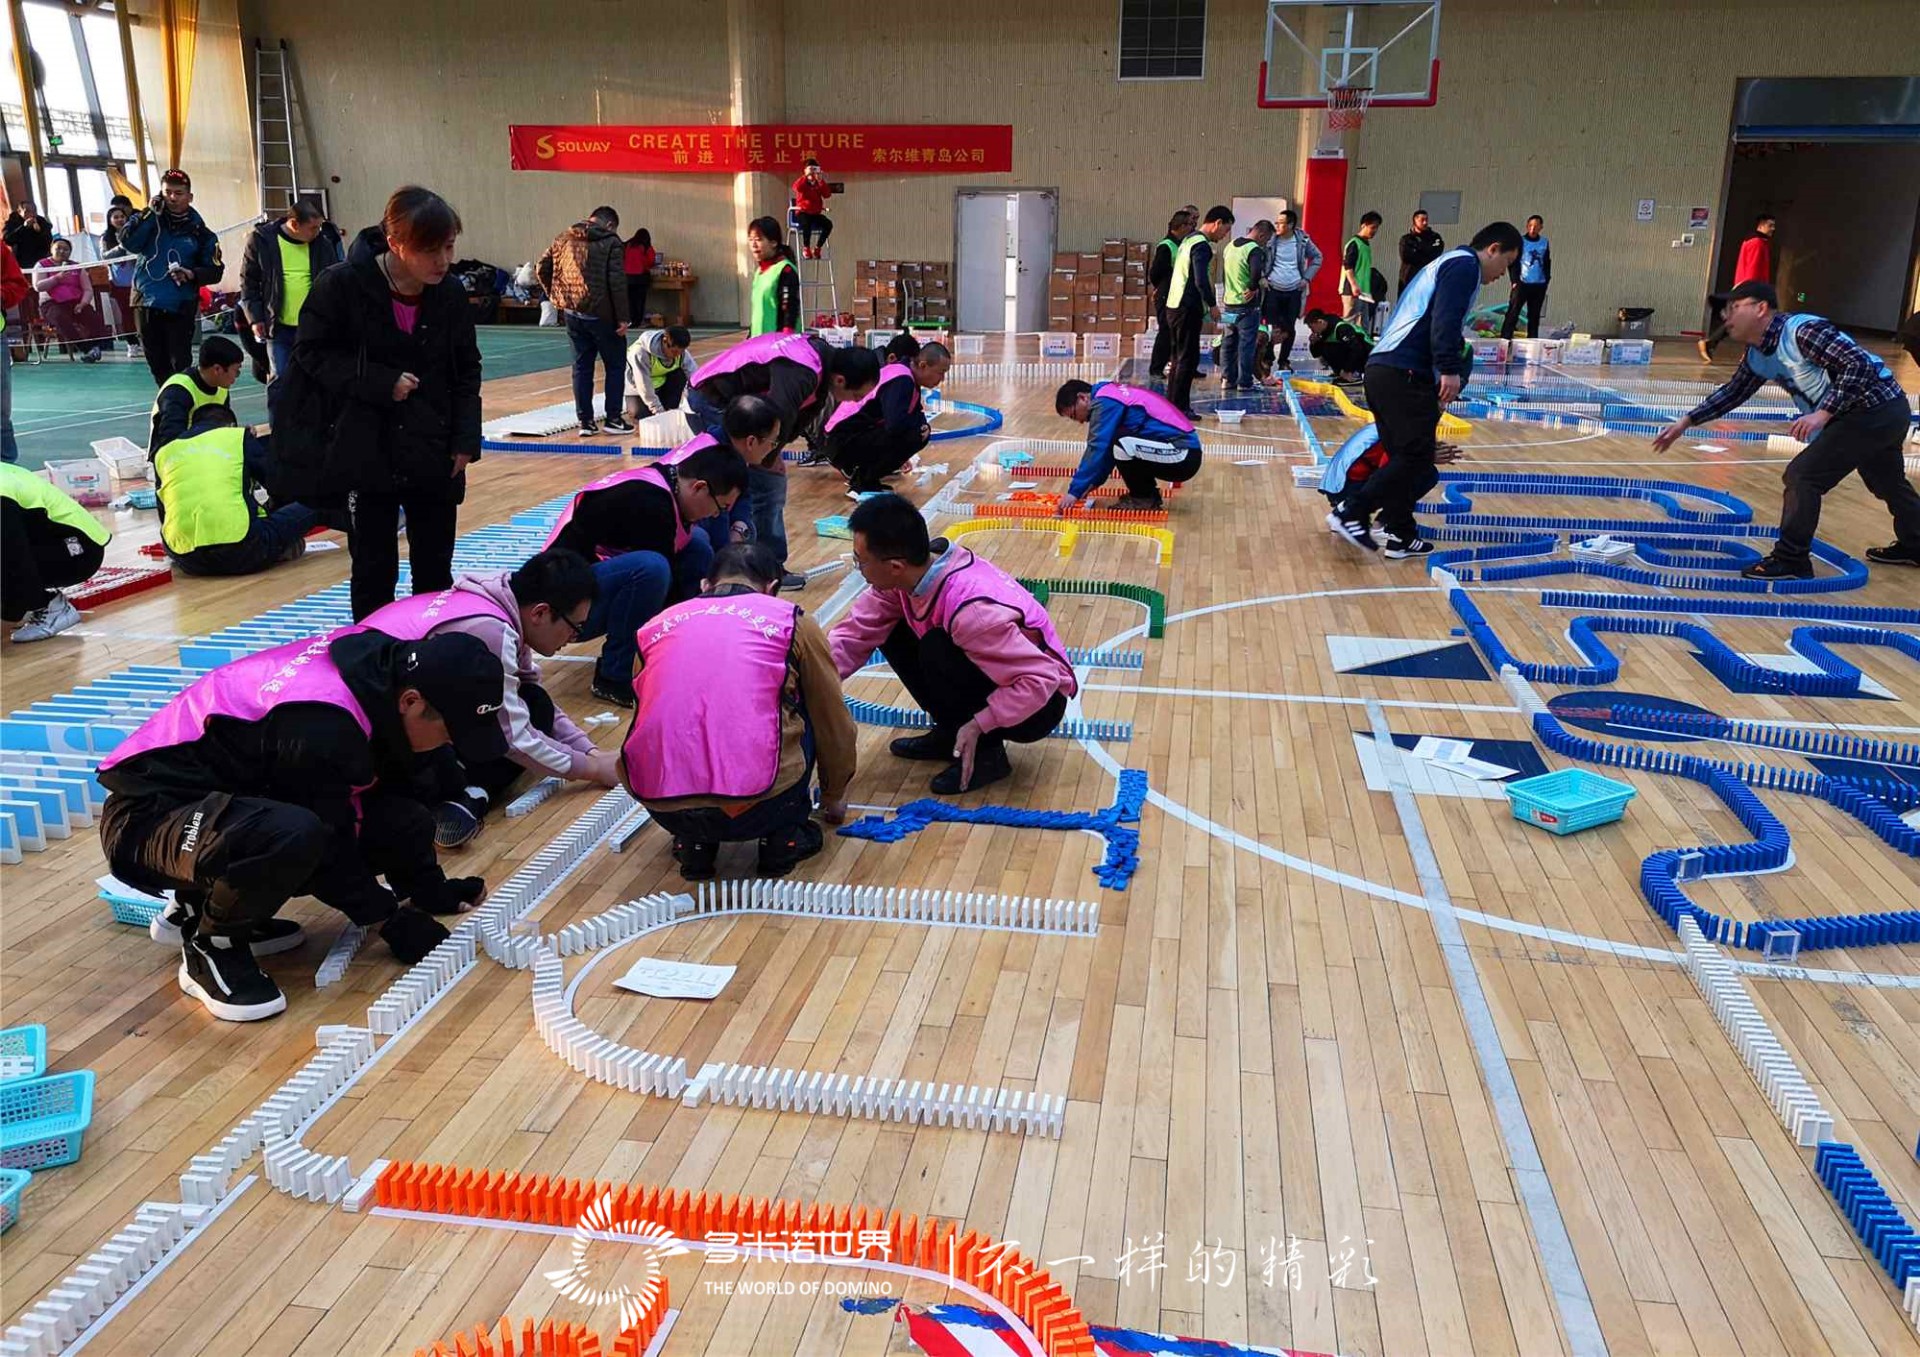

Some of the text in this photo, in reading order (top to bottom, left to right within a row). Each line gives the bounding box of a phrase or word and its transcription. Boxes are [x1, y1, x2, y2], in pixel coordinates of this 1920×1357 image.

[556, 140, 612, 153] SOLVAY
[628, 133, 865, 149] CREATE THE FUTURE
[872, 148, 985, 164] 索尔维青岛公司
[181, 811, 204, 853] Problem
